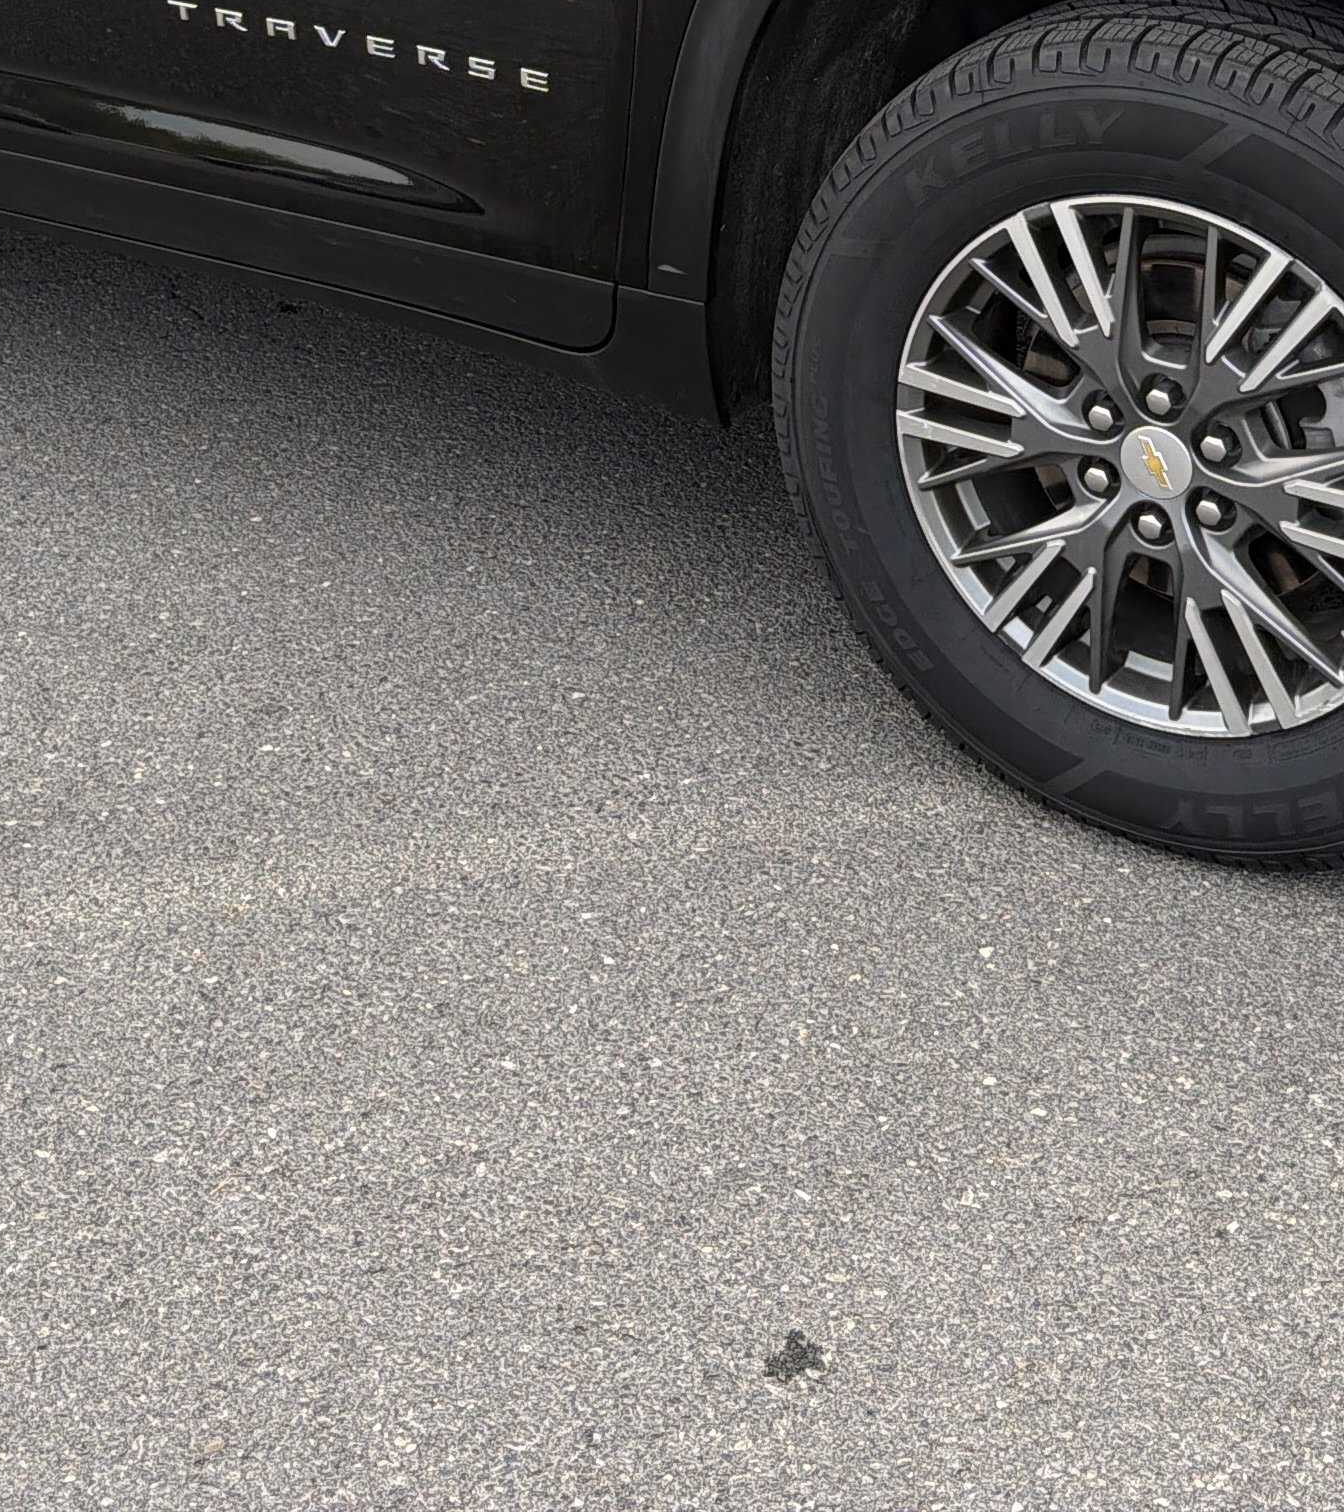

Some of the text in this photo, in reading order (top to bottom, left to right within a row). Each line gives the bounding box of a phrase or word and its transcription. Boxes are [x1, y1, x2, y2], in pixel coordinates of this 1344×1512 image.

[909, 106, 1125, 208] KELLY
[810, 395, 859, 553] TOURING
[859, 581, 934, 673] EDGE
